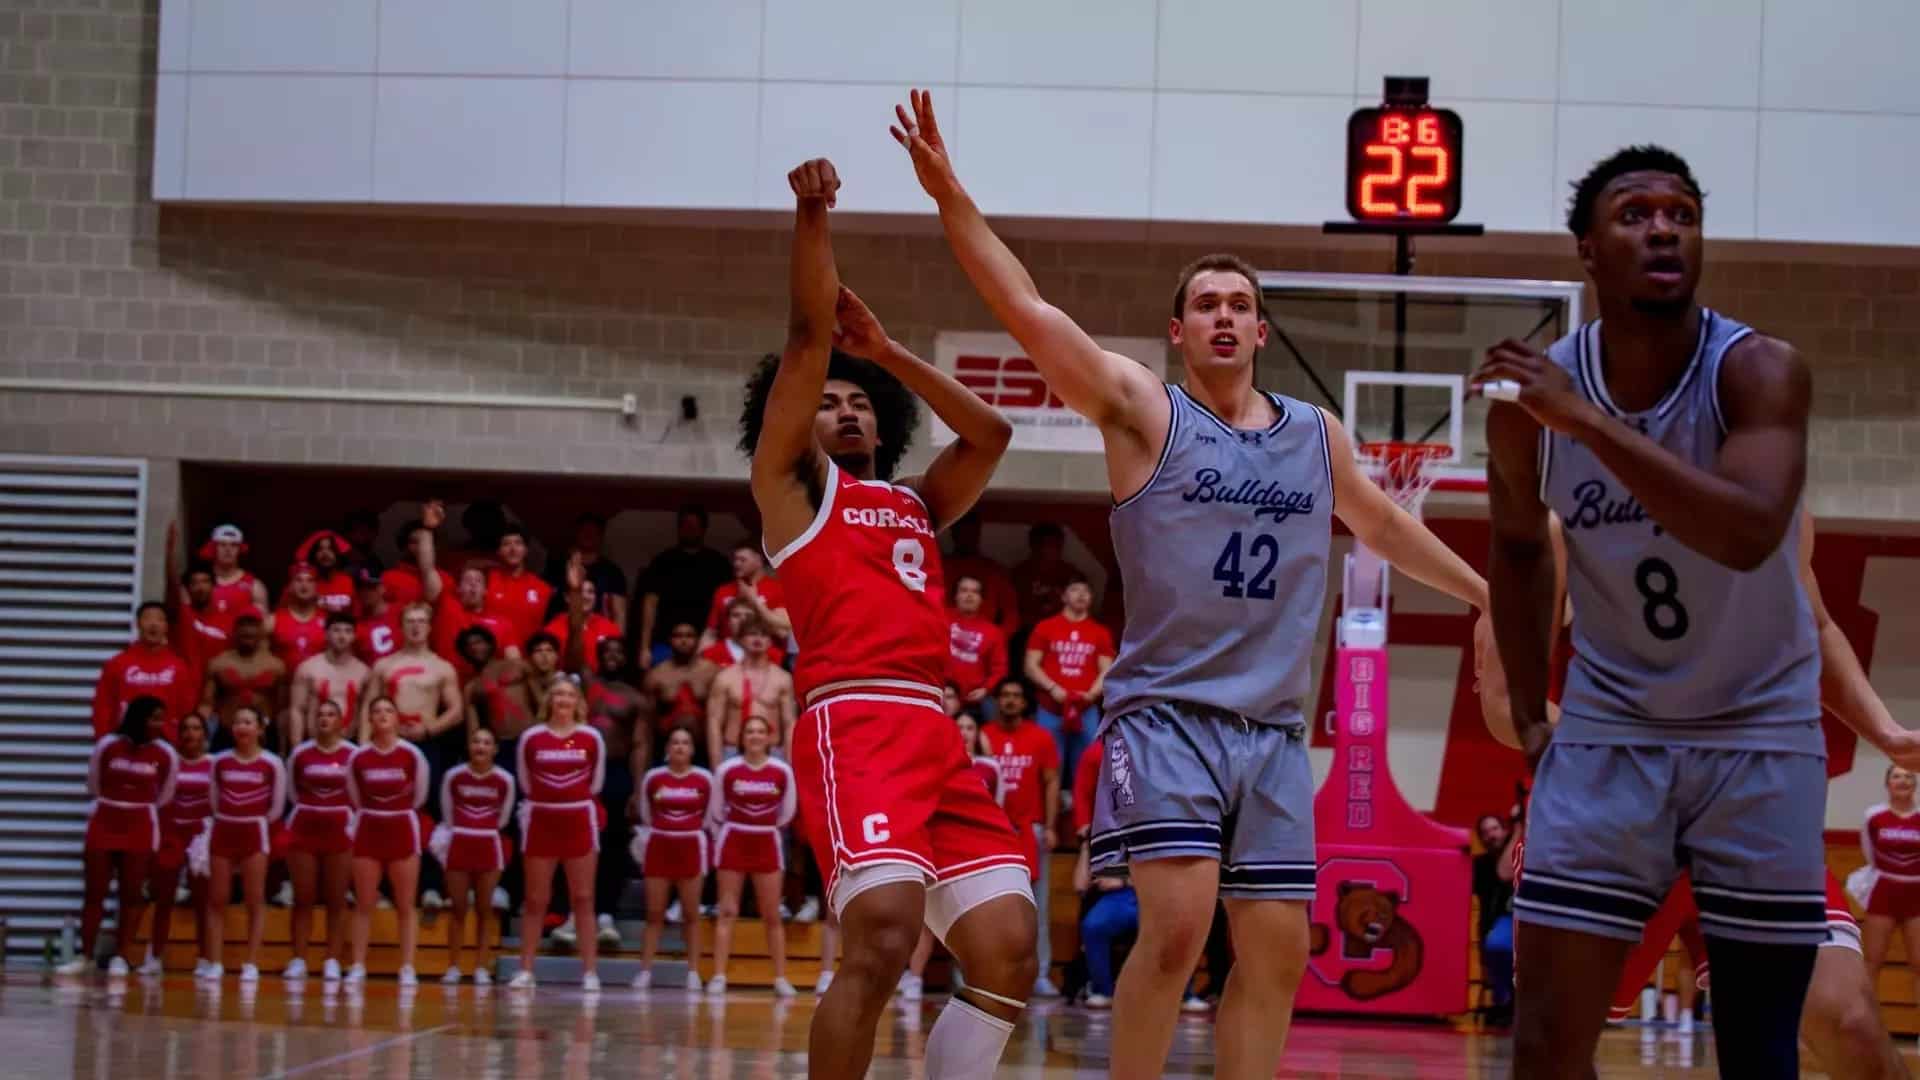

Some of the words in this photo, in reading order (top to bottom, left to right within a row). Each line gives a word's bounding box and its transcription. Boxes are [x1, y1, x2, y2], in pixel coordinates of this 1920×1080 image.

[1361, 145, 1448, 214] 22
[955, 355, 1064, 408] ES
[1182, 468, 1314, 523] Bulldogs
[892, 538, 928, 592] 8
[1213, 531, 1279, 600] 42
[1635, 557, 1689, 640] 8
[371, 624, 394, 653] C
[1349, 656, 1375, 736] BIG
[1347, 744, 1374, 829] RED
[862, 812, 890, 844] C
